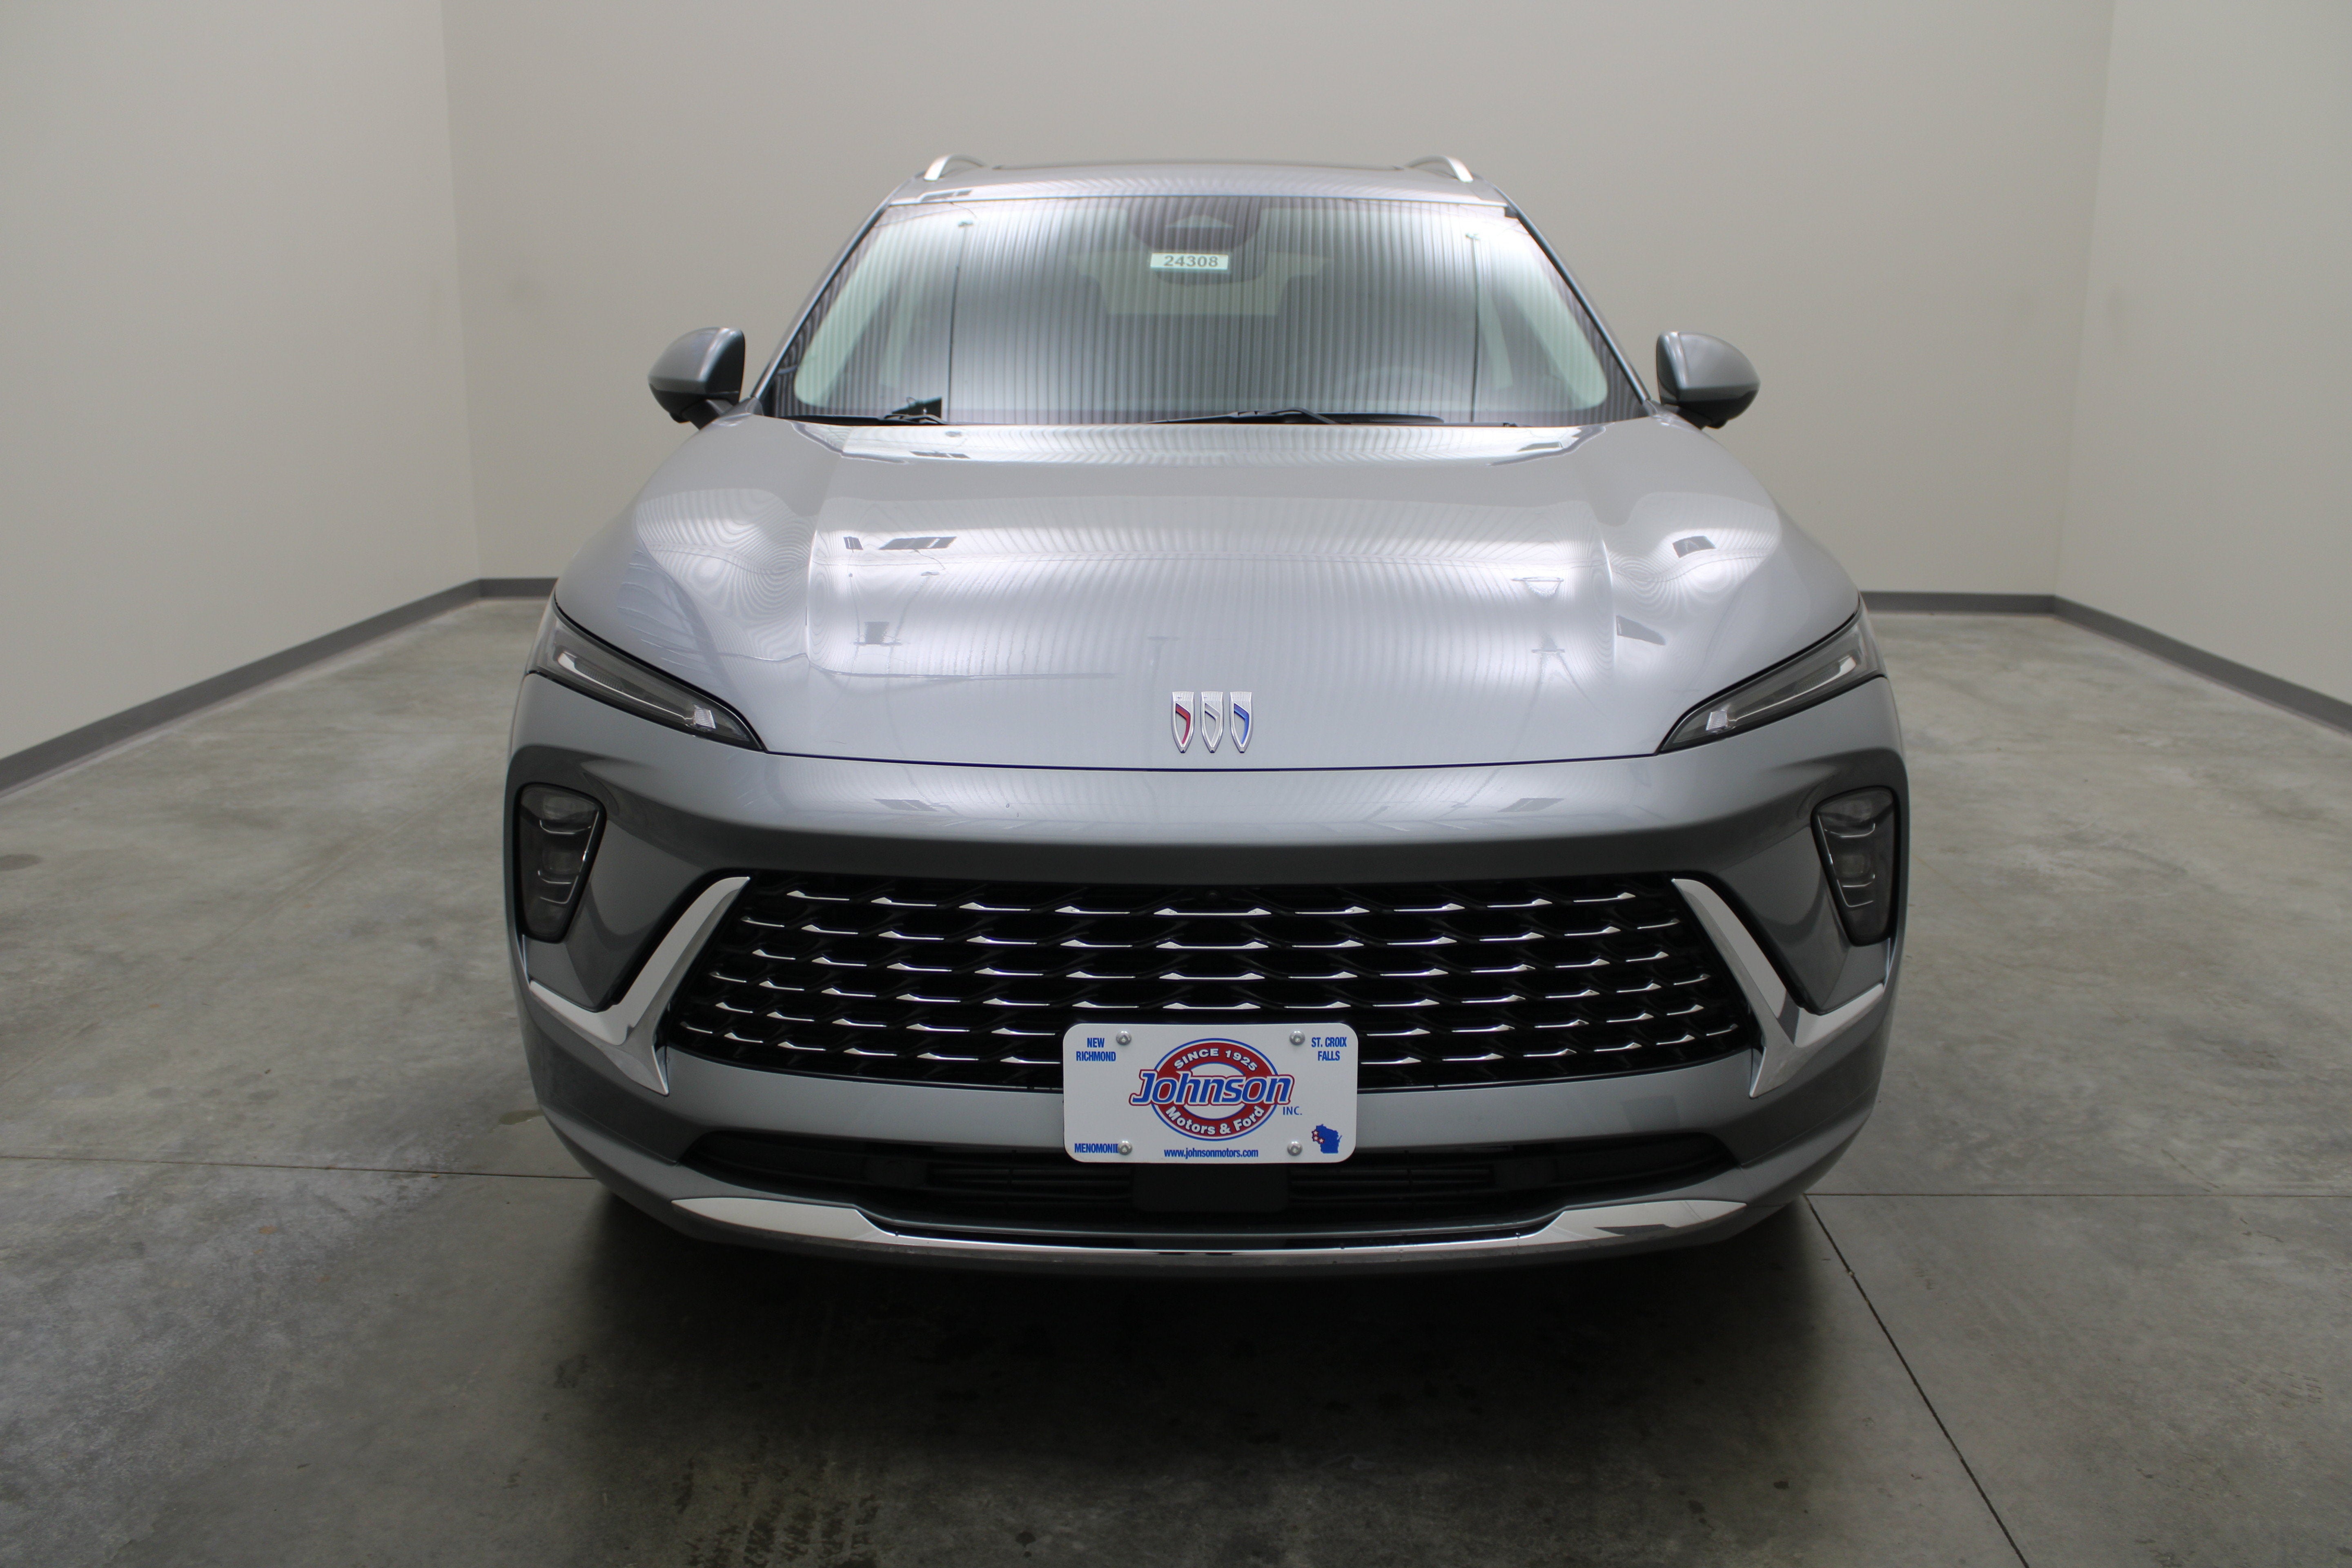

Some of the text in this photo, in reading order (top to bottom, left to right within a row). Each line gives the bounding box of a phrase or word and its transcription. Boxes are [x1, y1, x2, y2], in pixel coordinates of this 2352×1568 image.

[1164, 255, 1218, 267] 24308
[1087, 1038, 1105, 1048] NEW
[1311, 1037, 1347, 1047] ST. CROIX
[1076, 1051, 1116, 1062] RICHMOND
[1174, 1048, 1258, 1071] SINCE 1925
[1318, 1051, 1340, 1061] FALLS
[1129, 1069, 1295, 1106] Johnson
[1283, 1107, 1303, 1115] INC.
[1165, 1106, 1265, 1135] Motors & Ford
[1164, 1148, 1258, 1159] www.johnsonmotors.com
